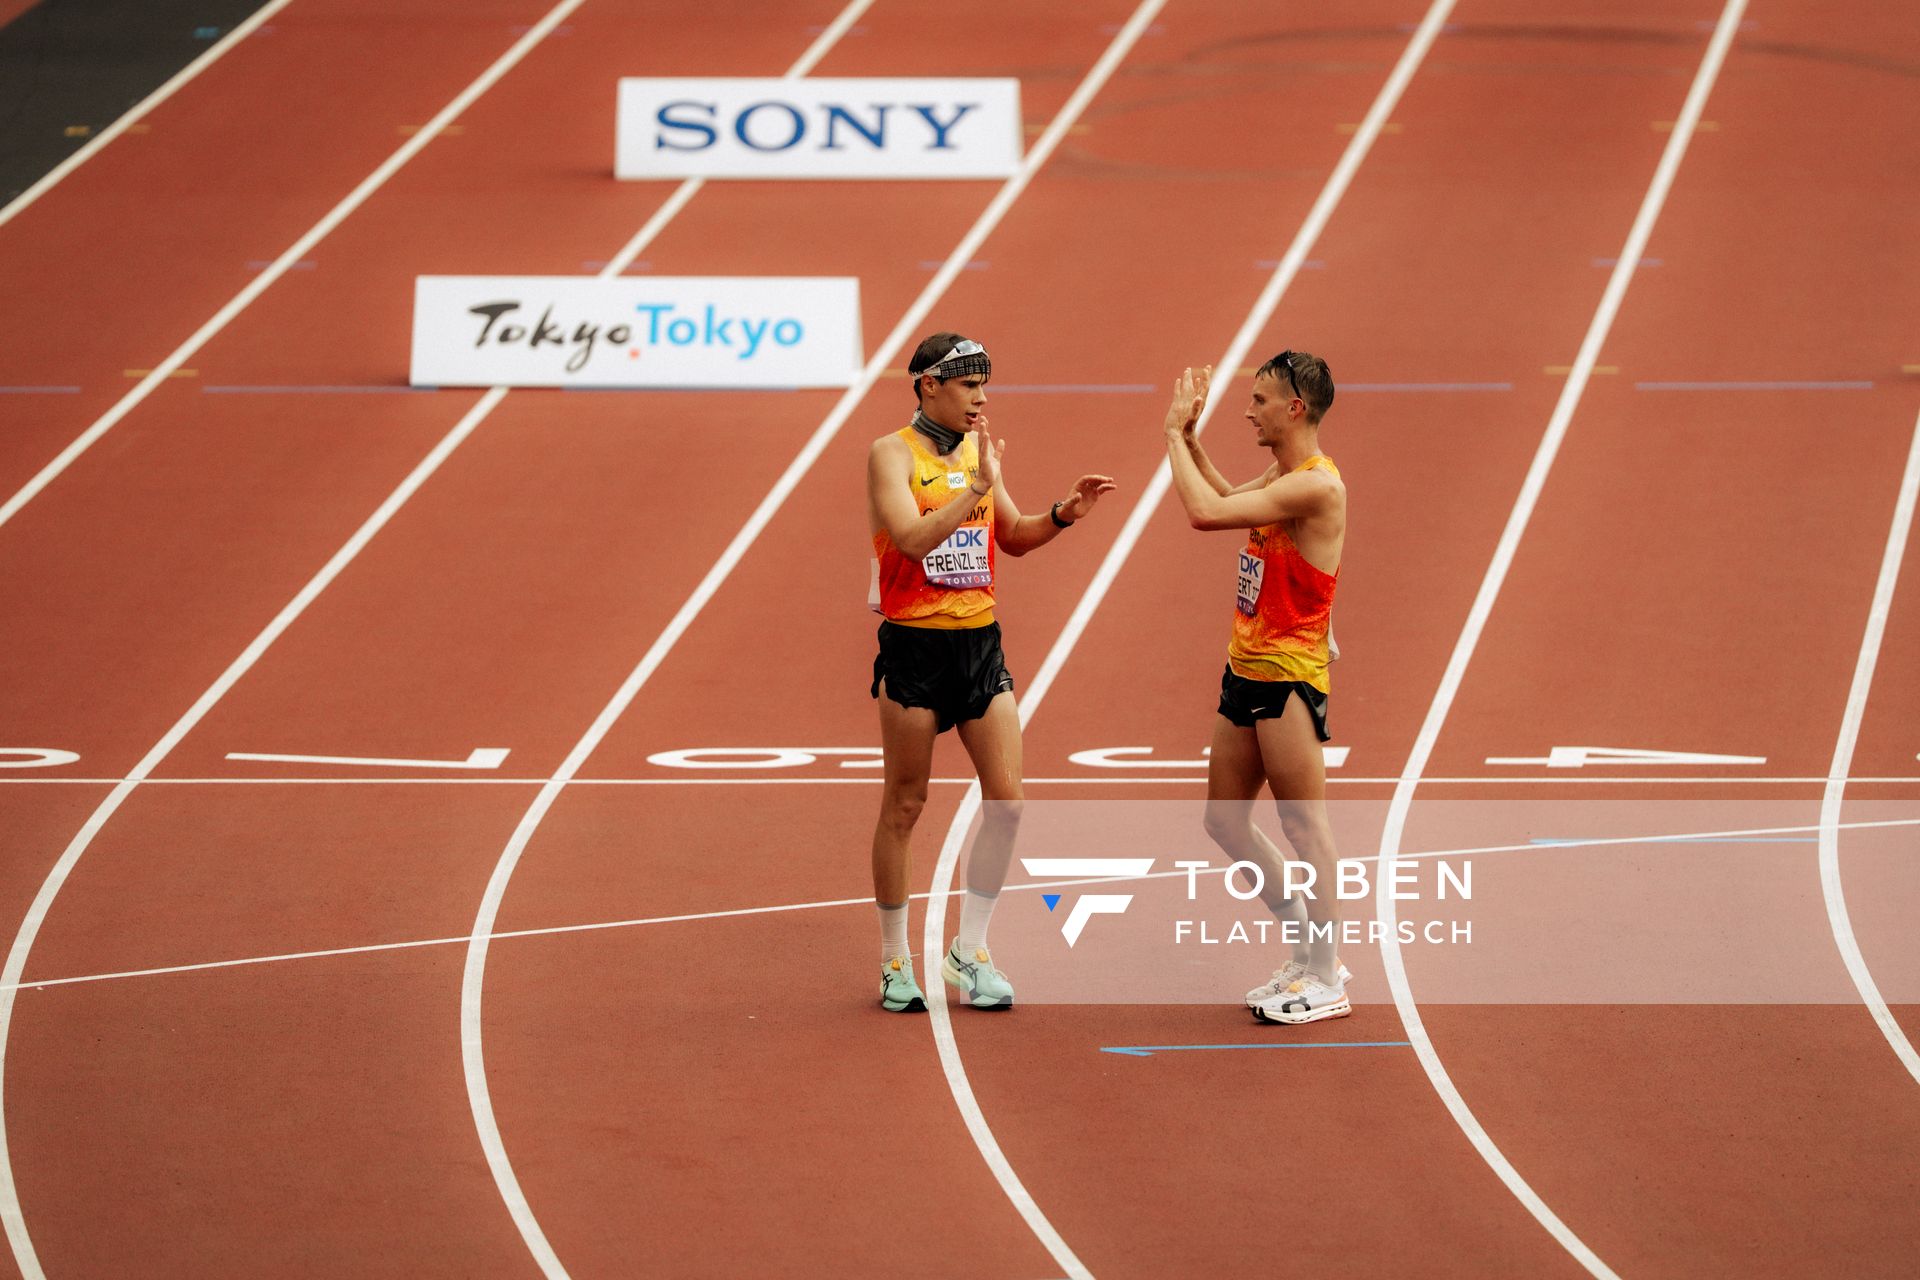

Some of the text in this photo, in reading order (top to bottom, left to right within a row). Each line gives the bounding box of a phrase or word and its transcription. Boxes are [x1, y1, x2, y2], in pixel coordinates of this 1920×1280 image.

[655, 100, 981, 152] SONY
[467, 301, 806, 373] Tokyo Tokyo
[926, 552, 975, 573] FRENZL
[1240, 554, 1261, 578] DK
[1486, 747, 1766, 767] 4
